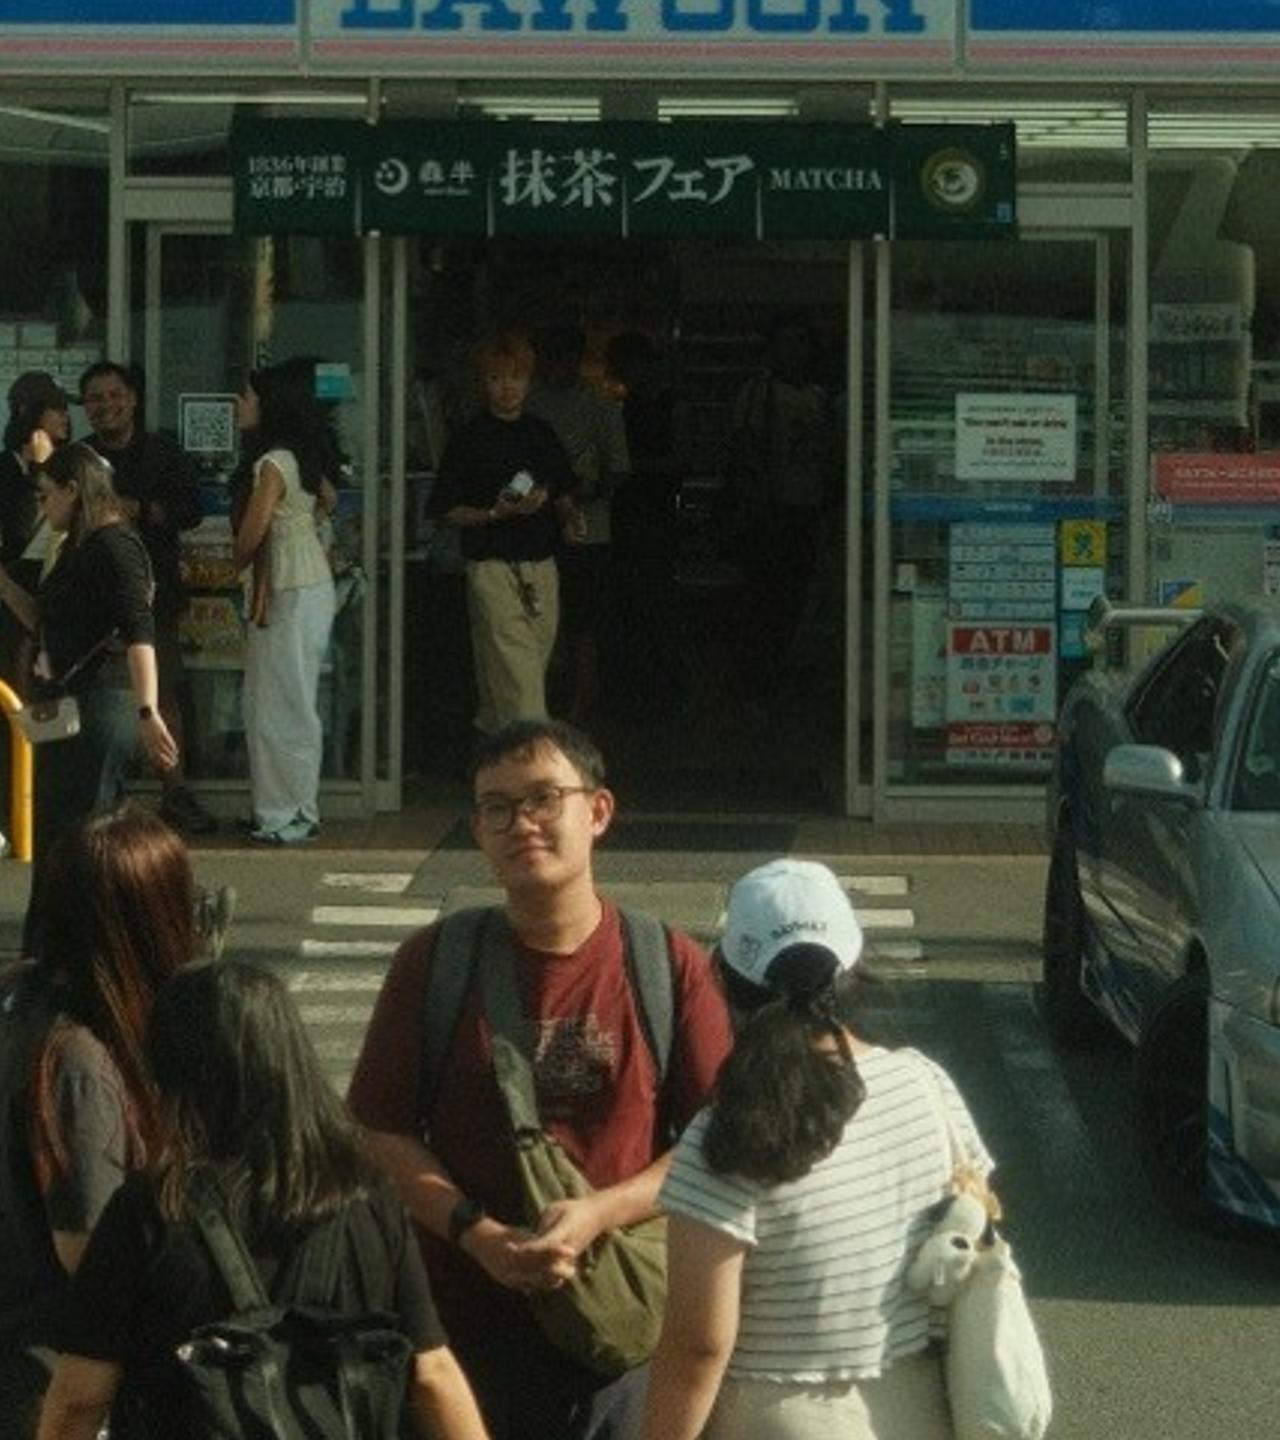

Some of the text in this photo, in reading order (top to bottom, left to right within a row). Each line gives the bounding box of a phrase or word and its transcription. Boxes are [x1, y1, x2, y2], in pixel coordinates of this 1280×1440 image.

[499, 149, 755, 208] 抹茶フェア
[770, 168, 882, 191] MATCHA
[968, 628, 1037, 653] ATM
